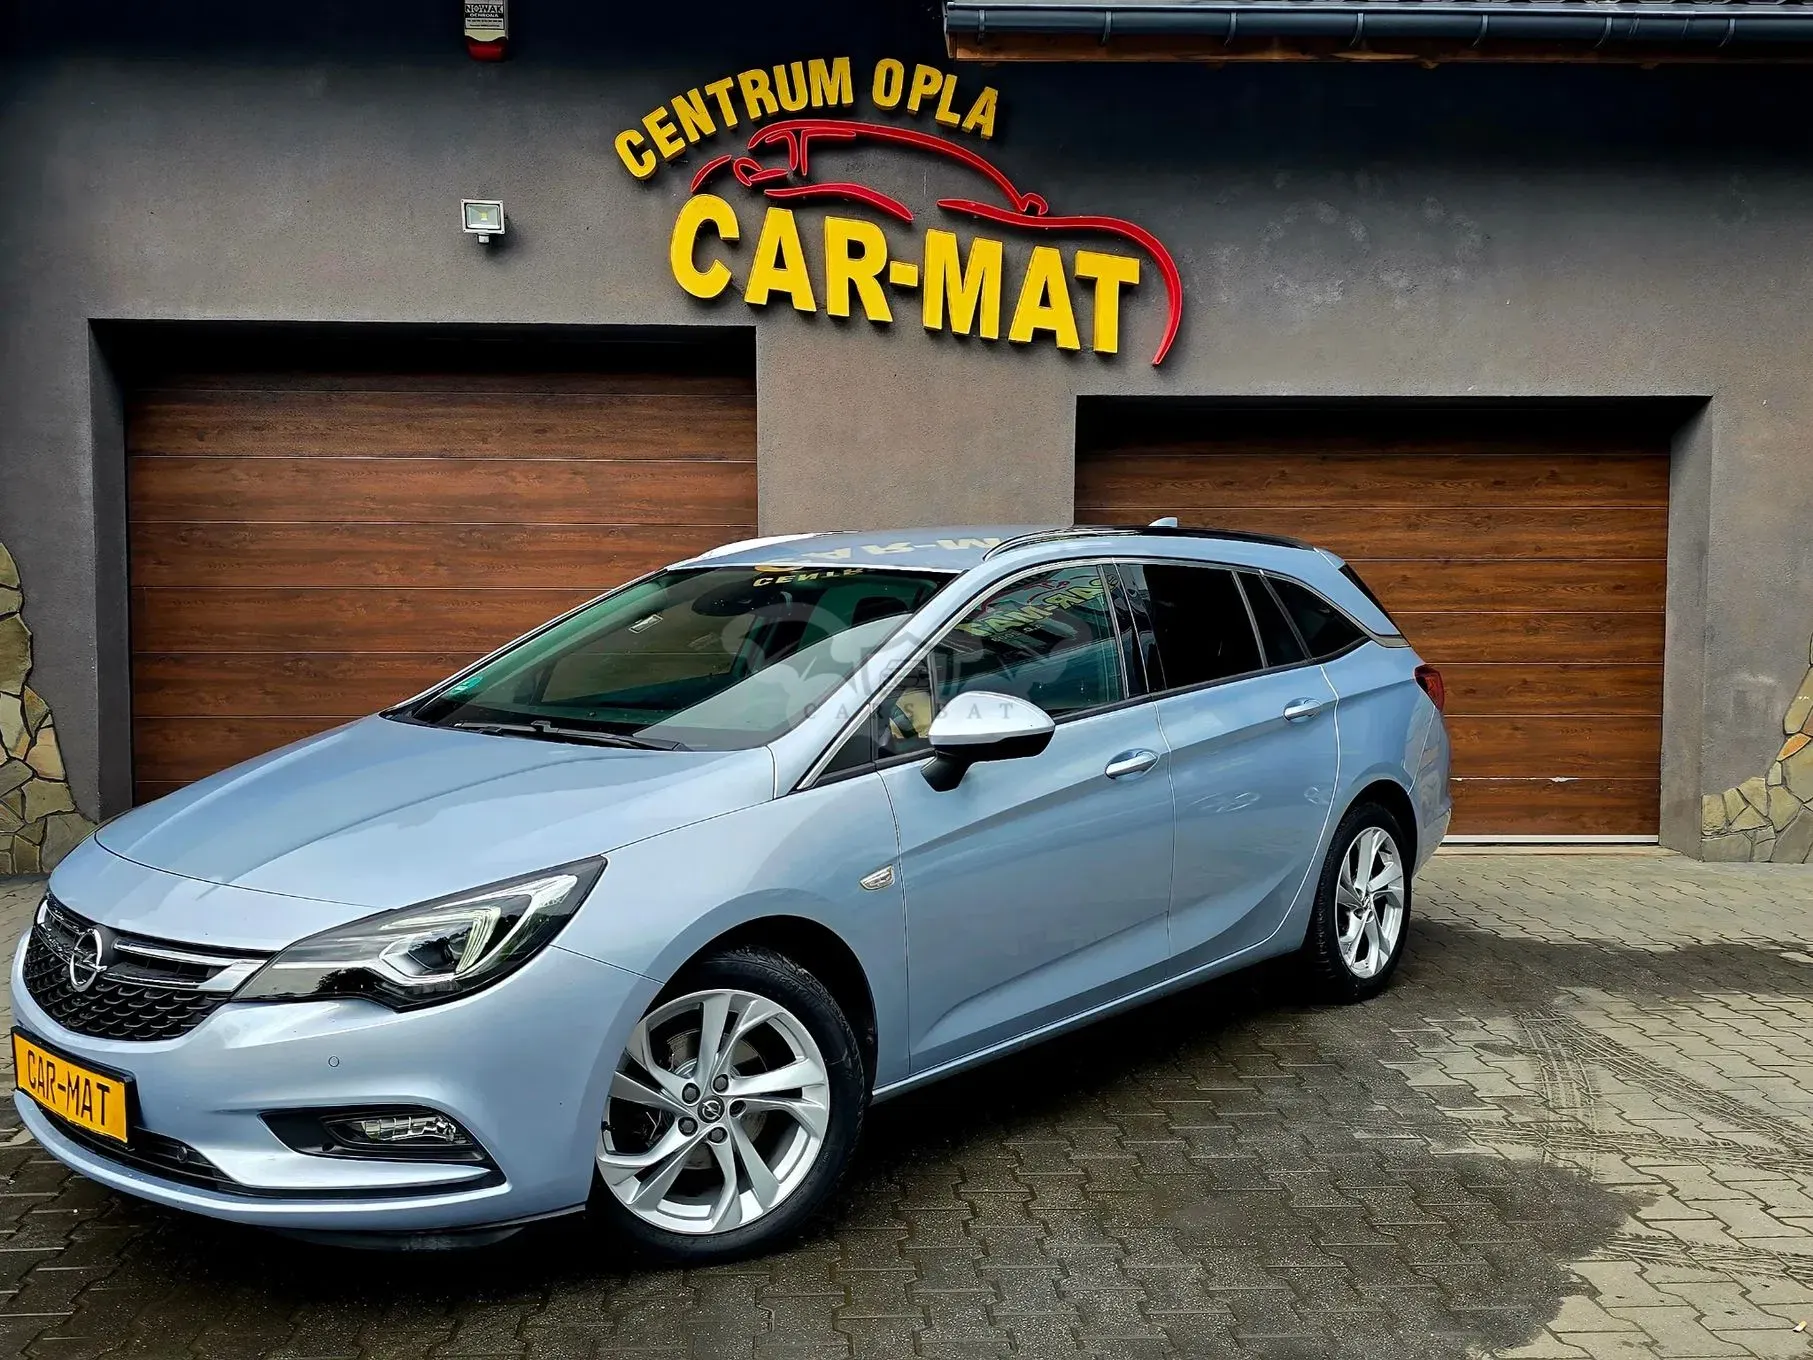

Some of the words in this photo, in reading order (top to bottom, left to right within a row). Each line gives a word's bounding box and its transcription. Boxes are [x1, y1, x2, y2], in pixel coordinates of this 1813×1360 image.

[465, 4, 503, 13] NOWAK
[614, 57, 854, 181] CENTRUM
[872, 58, 999, 140] OPLA
[670, 193, 1140, 355] CAR-MAT
[27, 1049, 111, 1126] CAR-MAT
